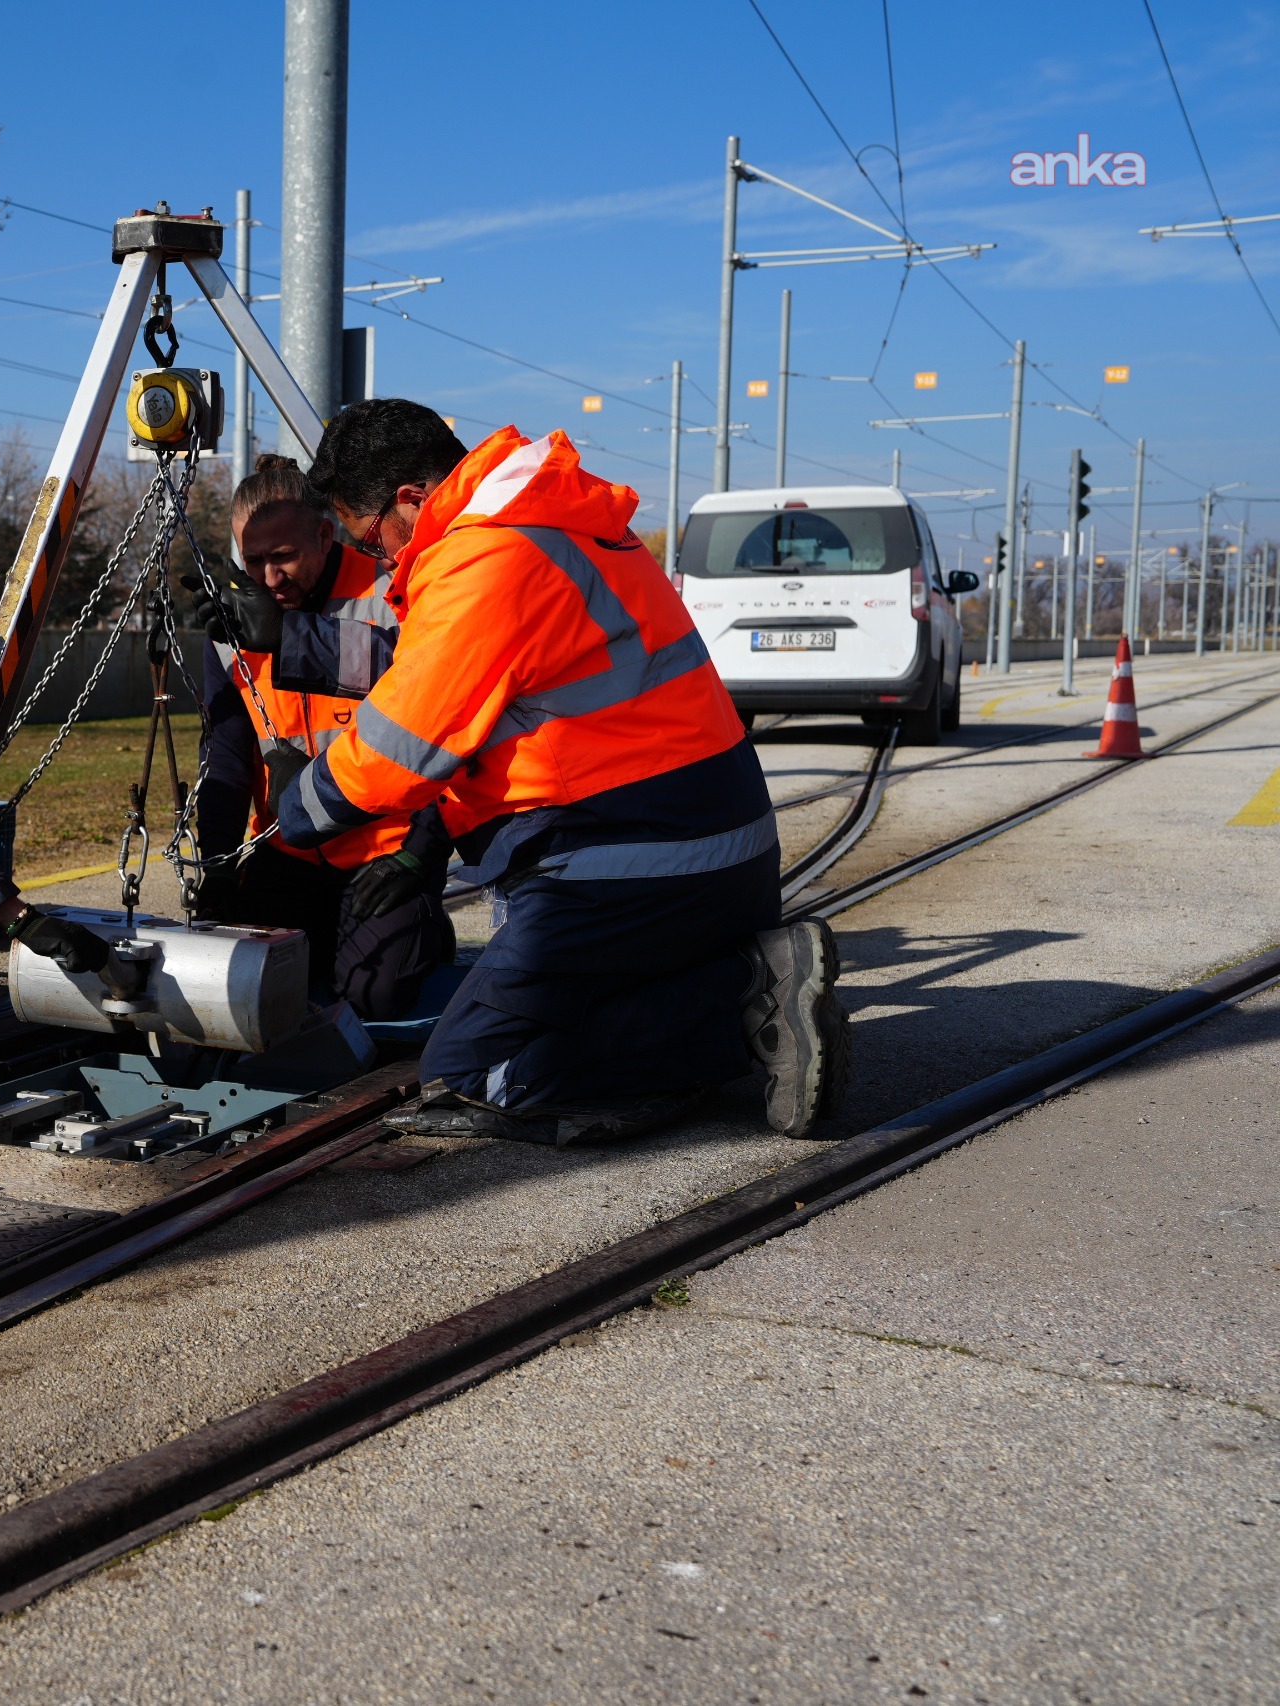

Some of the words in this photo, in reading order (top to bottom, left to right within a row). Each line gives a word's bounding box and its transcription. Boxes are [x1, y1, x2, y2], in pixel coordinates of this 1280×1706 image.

[146, 392, 163, 423] Yale
[738, 600, 851, 608] TOURNEO
[759, 633, 774, 646] 26
[781, 632, 803, 646] AKS
[810, 632, 832, 646] 236
